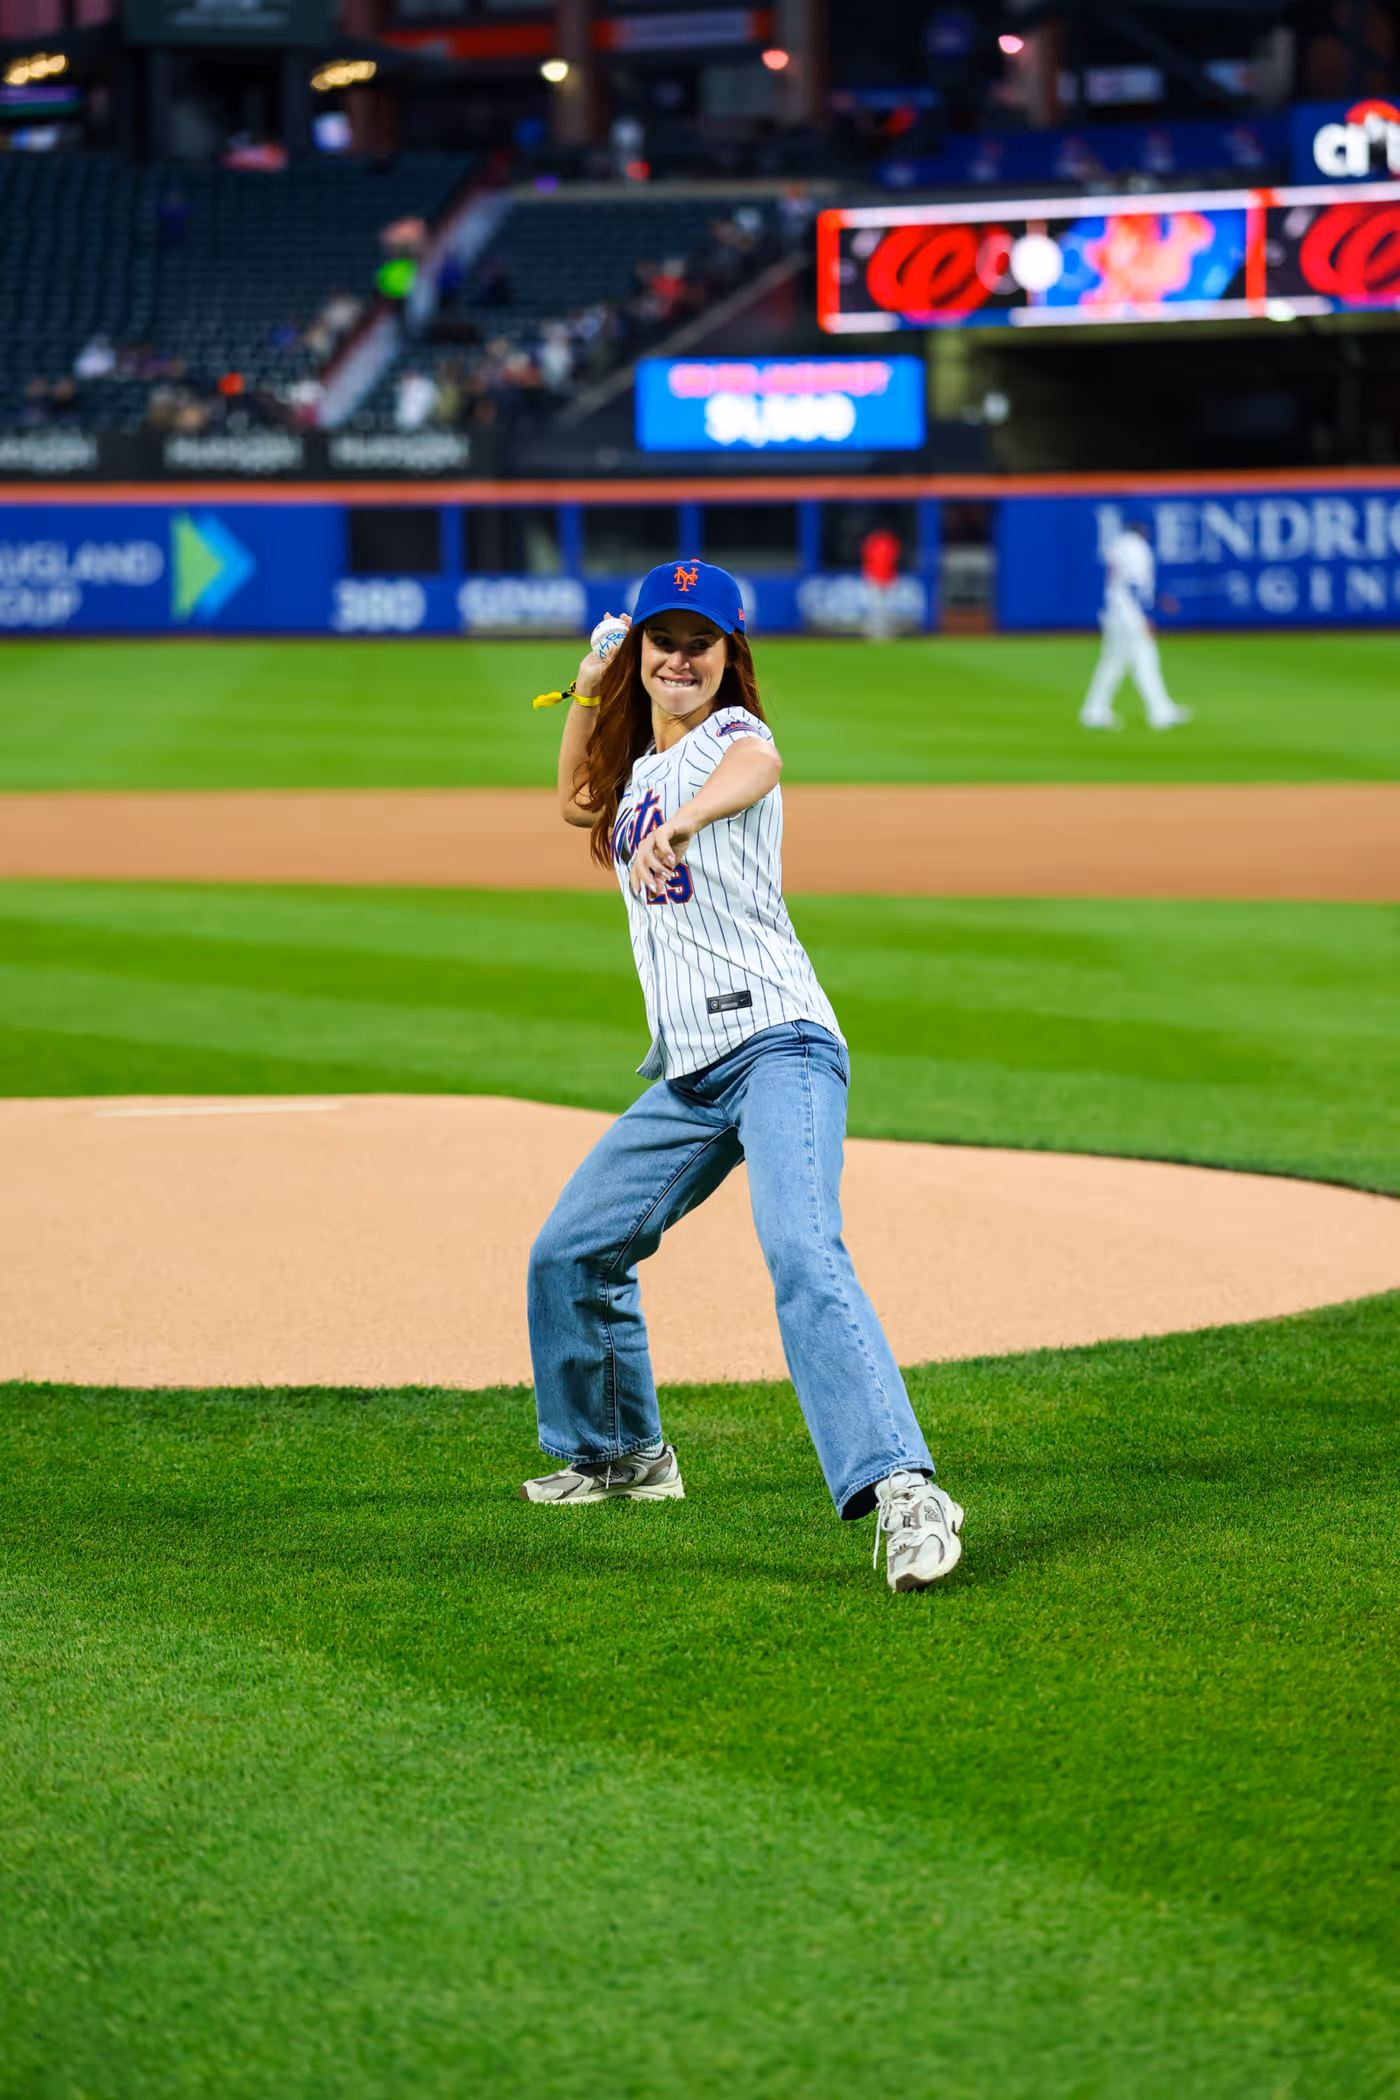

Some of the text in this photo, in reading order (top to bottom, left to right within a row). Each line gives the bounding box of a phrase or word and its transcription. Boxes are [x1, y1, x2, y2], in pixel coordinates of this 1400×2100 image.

[1095, 497, 1400, 564] ENDRI
[333, 579, 426, 632] 380
[674, 566, 699, 592] NY
